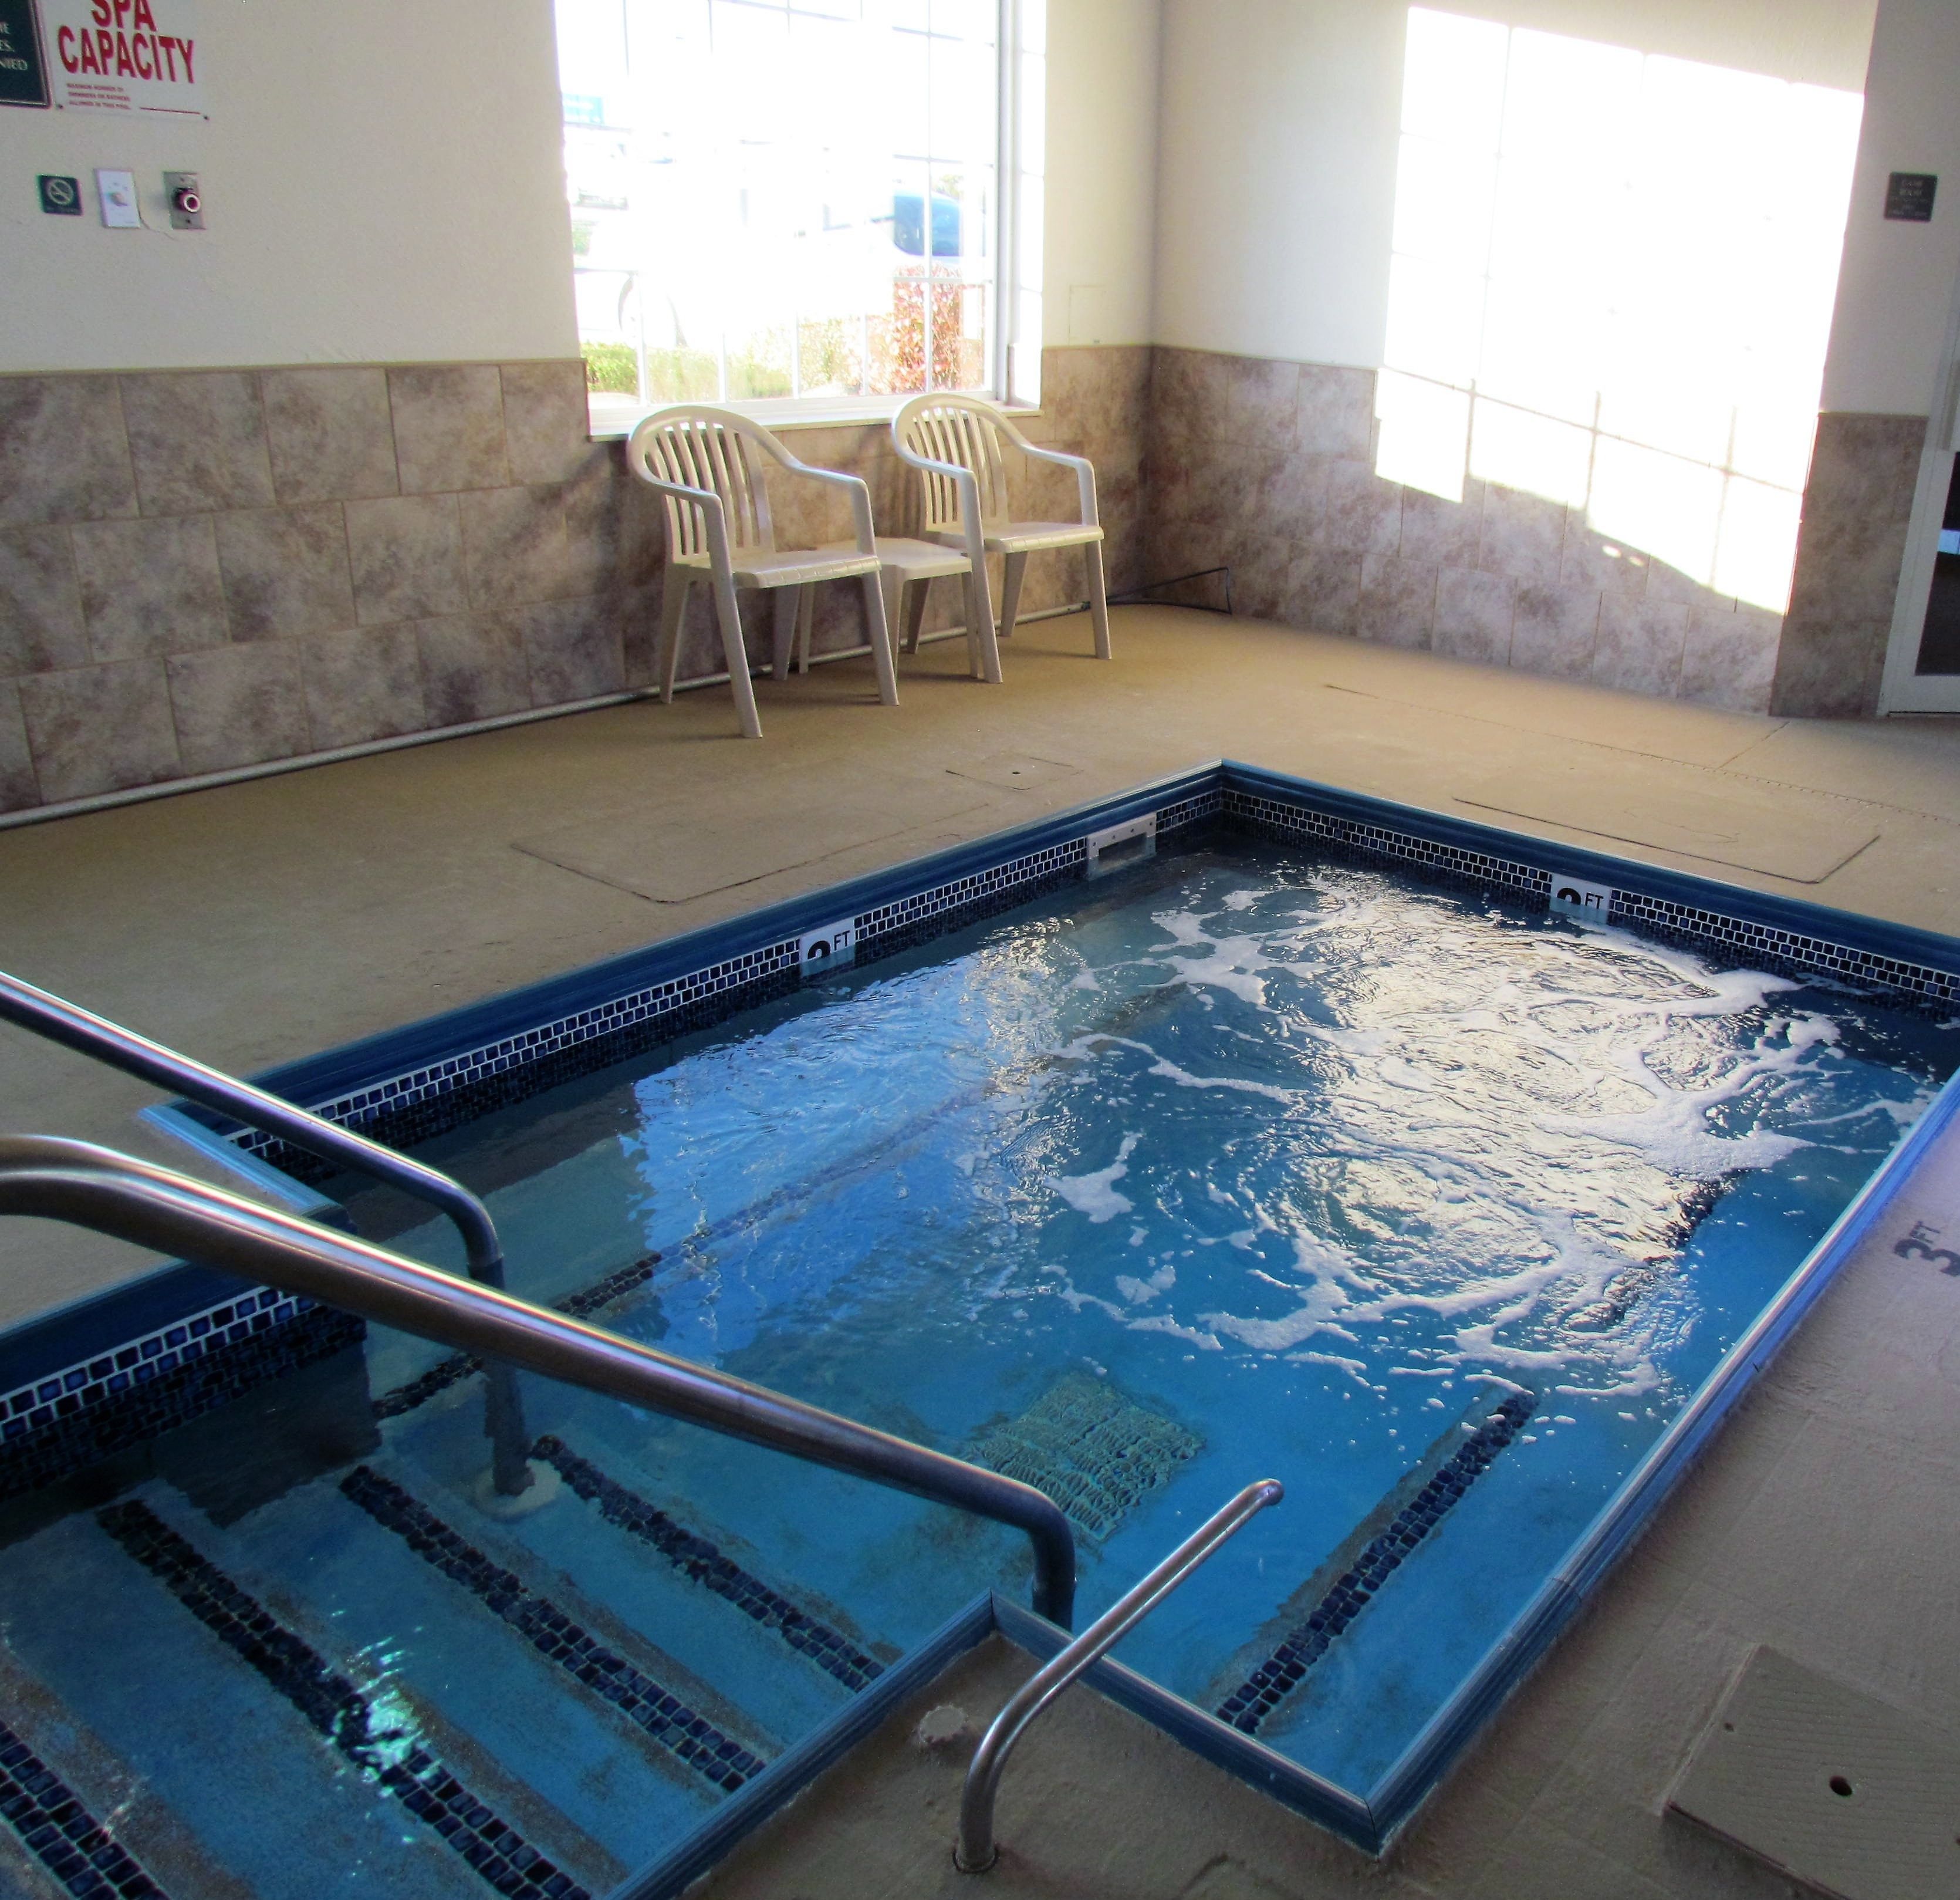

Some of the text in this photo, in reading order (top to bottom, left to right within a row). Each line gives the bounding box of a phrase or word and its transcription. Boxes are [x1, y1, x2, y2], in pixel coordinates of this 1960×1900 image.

[92, 0, 157, 32] SPA
[58, 25, 194, 83] CAPACITY
[1585, 892, 1604, 909] FT
[834, 930, 850, 951] FT
